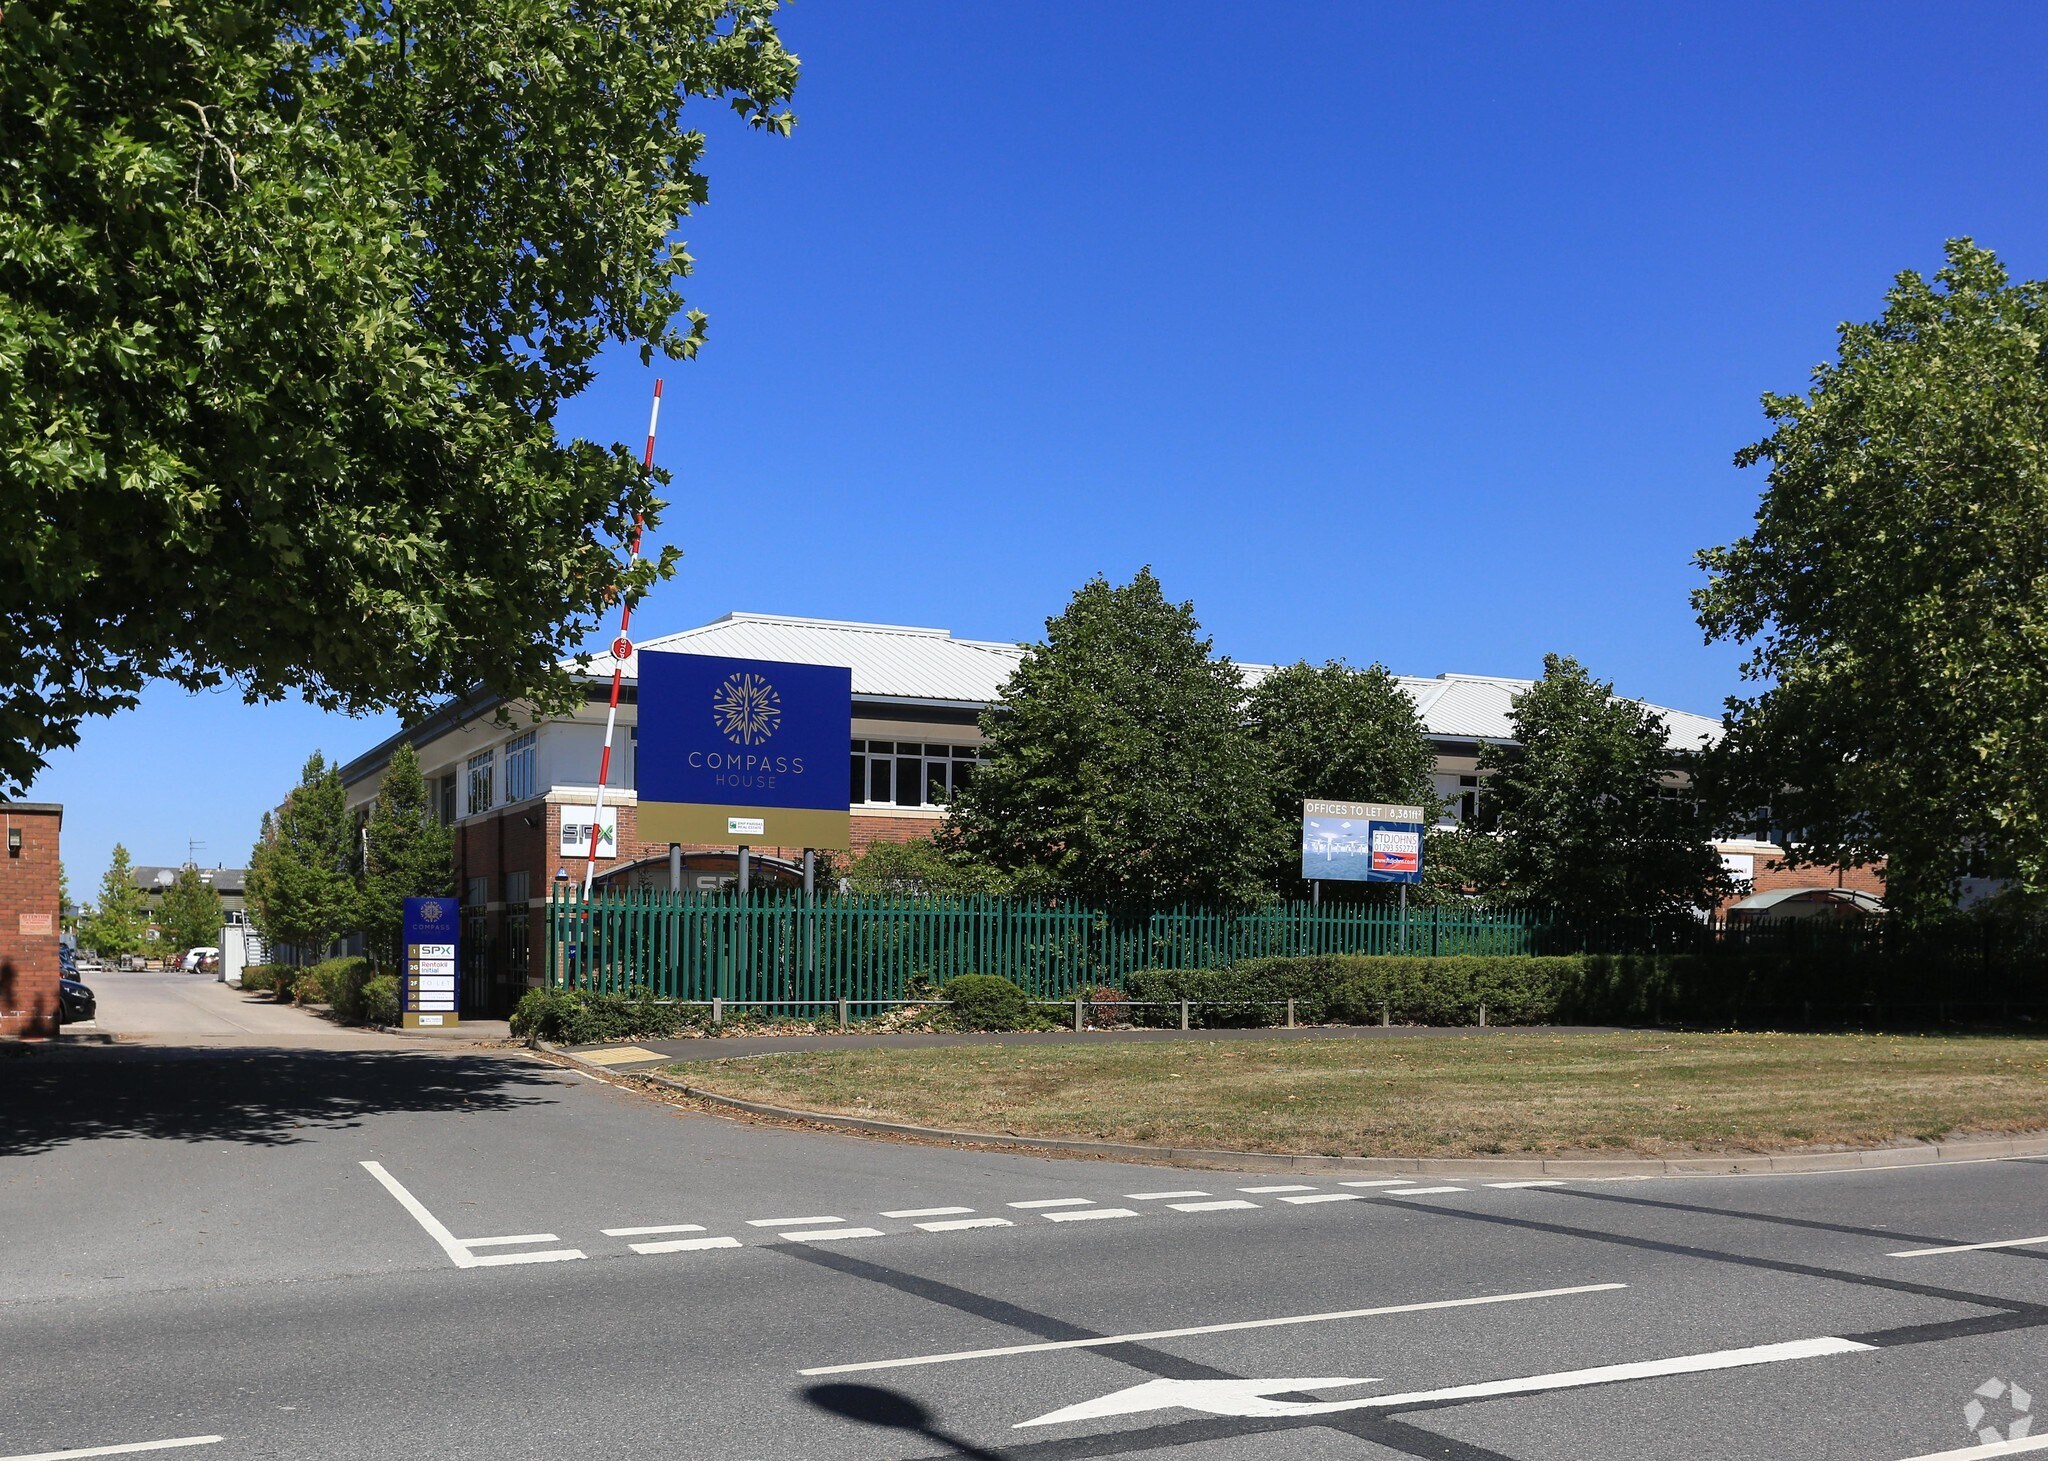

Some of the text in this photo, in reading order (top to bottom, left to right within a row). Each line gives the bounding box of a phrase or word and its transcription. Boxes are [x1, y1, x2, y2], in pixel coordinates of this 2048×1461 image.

[619, 638, 627, 658] STOP
[688, 751, 804, 774] COMPASS
[716, 774, 776, 789] HOUSE
[1306, 802, 1348, 815] OFFICES
[1350, 805, 1364, 816] TO
[1366, 806, 1382, 817] LET
[1374, 833, 1417, 845] FTDJOHNS
[1375, 844, 1393, 852] 01293
[421, 946, 451, 955] SPX
